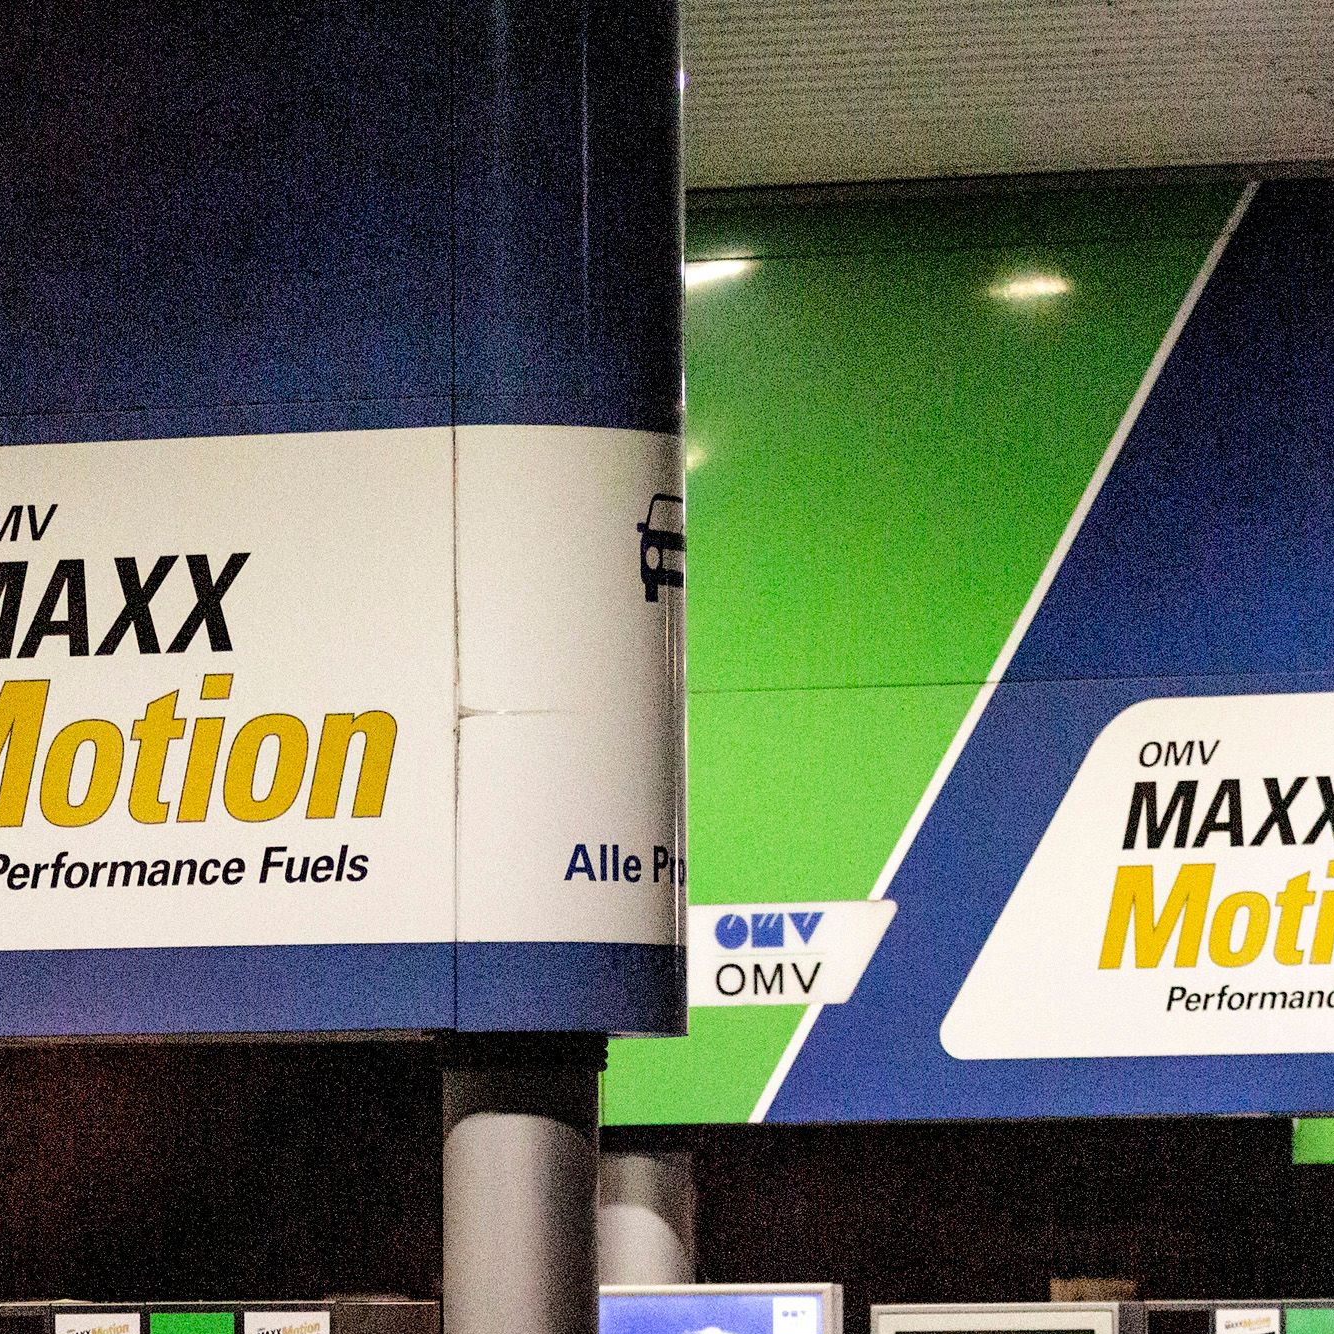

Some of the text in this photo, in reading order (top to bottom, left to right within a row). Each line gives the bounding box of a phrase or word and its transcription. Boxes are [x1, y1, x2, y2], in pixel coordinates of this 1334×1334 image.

[1139, 739, 1220, 768] OMV
[258, 845, 370, 886] Fuels
[564, 844, 642, 883] Alle
[716, 962, 822, 996] OMV
